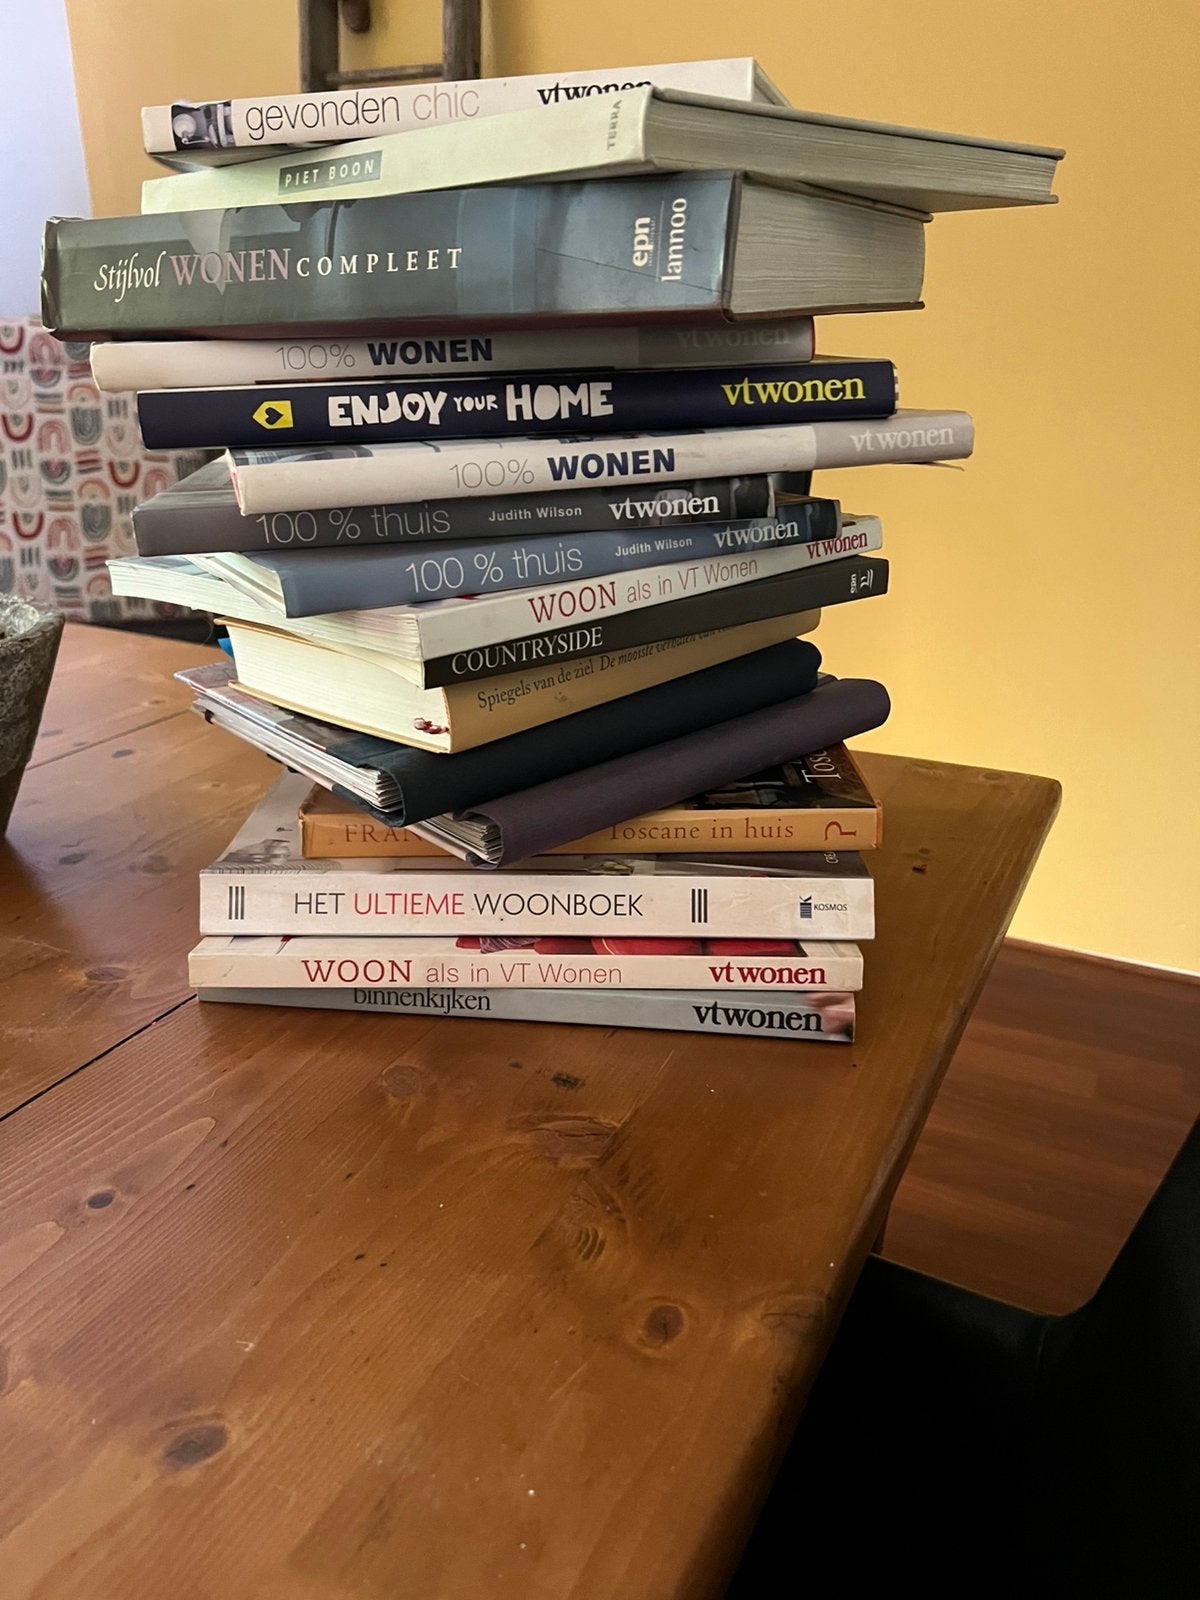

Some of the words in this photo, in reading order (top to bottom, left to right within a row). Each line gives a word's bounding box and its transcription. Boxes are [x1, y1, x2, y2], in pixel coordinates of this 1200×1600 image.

[245, 91, 400, 140] gevonden
[412, 85, 480, 120] chic
[607, 100, 622, 151] TERRA
[285, 169, 320, 187] PIET
[328, 159, 375, 181] BOON
[632, 217, 654, 268] epn
[661, 197, 688, 282] lannoo
[94, 251, 167, 303] Stijlvol
[169, 248, 292, 286] WONEN
[296, 248, 463, 277] COMPLEET
[274, 343, 356, 370] 100%
[367, 338, 493, 366] WONEN
[327, 391, 448, 427] ENJOY
[453, 394, 499, 413] YOUR
[505, 382, 614, 421] HOME
[449, 458, 536, 489] 100%
[547, 448, 676, 482] WONEN
[256, 510, 318, 544] 100
[328, 506, 361, 541] %
[370, 502, 451, 537] thuis
[488, 507, 532, 522] Judith
[536, 505, 583, 519] Wilson
[405, 557, 465, 593] 100
[473, 551, 504, 585] %
[512, 542, 583, 579] thuis
[615, 542, 652, 557] Judith
[655, 536, 693, 552] Wilson
[528, 581, 617, 624] WOON
[627, 579, 652, 604] als
[658, 575, 673, 596] in
[678, 566, 701, 591] VT
[704, 558, 759, 586] Wonen
[450, 626, 604, 678] COUNTRYSIDE
[477, 680, 532, 712] Spiegels
[534, 675, 556, 691] van
[557, 667, 572, 684] de
[574, 658, 595, 679] ziel
[600, 654, 616, 671] De
[711, 819, 733, 838] in
[744, 817, 795, 838] huis
[294, 892, 346, 915] HET
[353, 893, 466, 915] ULTIEME
[473, 893, 644, 916] WOONBOEK
[813, 903, 848, 912] KOSMOS
[301, 959, 412, 983] WOON
[426, 963, 459, 983] als
[470, 963, 490, 983] in
[500, 963, 531, 982] VT
[538, 963, 622, 983] Wonen
[353, 987, 491, 1014] binnenkijken
